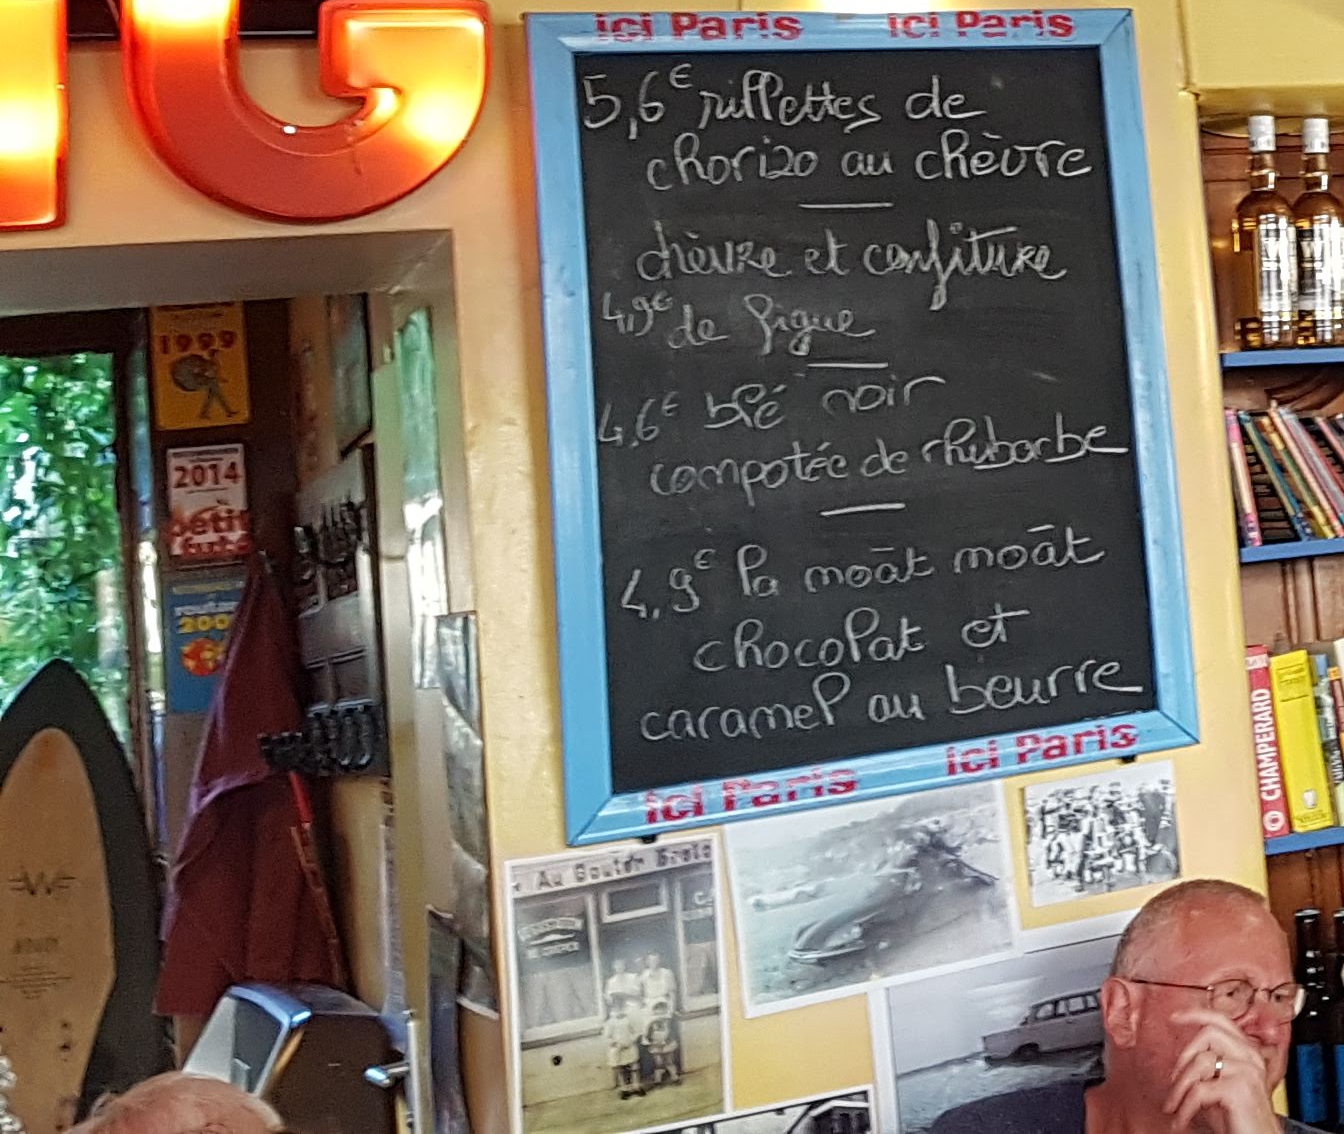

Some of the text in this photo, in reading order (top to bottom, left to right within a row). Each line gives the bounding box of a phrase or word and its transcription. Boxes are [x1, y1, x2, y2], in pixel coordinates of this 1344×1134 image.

[595, 12, 804, 42] ici Paris
[955, 9, 1075, 38] Paris
[699, 69, 882, 133] rillettes
[905, 73, 987, 120] de
[646, 129, 1093, 191] chorizo au chèvre
[804, 228, 848, 277] et
[862, 218, 1069, 311] confiture
[667, 303, 730, 350] de
[743, 293, 877, 356] figue
[704, 382, 788, 430] blé
[821, 374, 946, 415] noir
[173, 461, 244, 489] 2014
[650, 411, 1128, 507] compotée de rhubarbe
[737, 543, 780, 598] la
[178, 613, 233, 634] 200
[693, 602, 1032, 673] chocolat et
[640, 656, 1145, 743] caramel au beurre
[1015, 723, 1140, 770] Paris
[1250, 687, 1283, 802] CHAMPERARD
[723, 768, 859, 814] Paris
